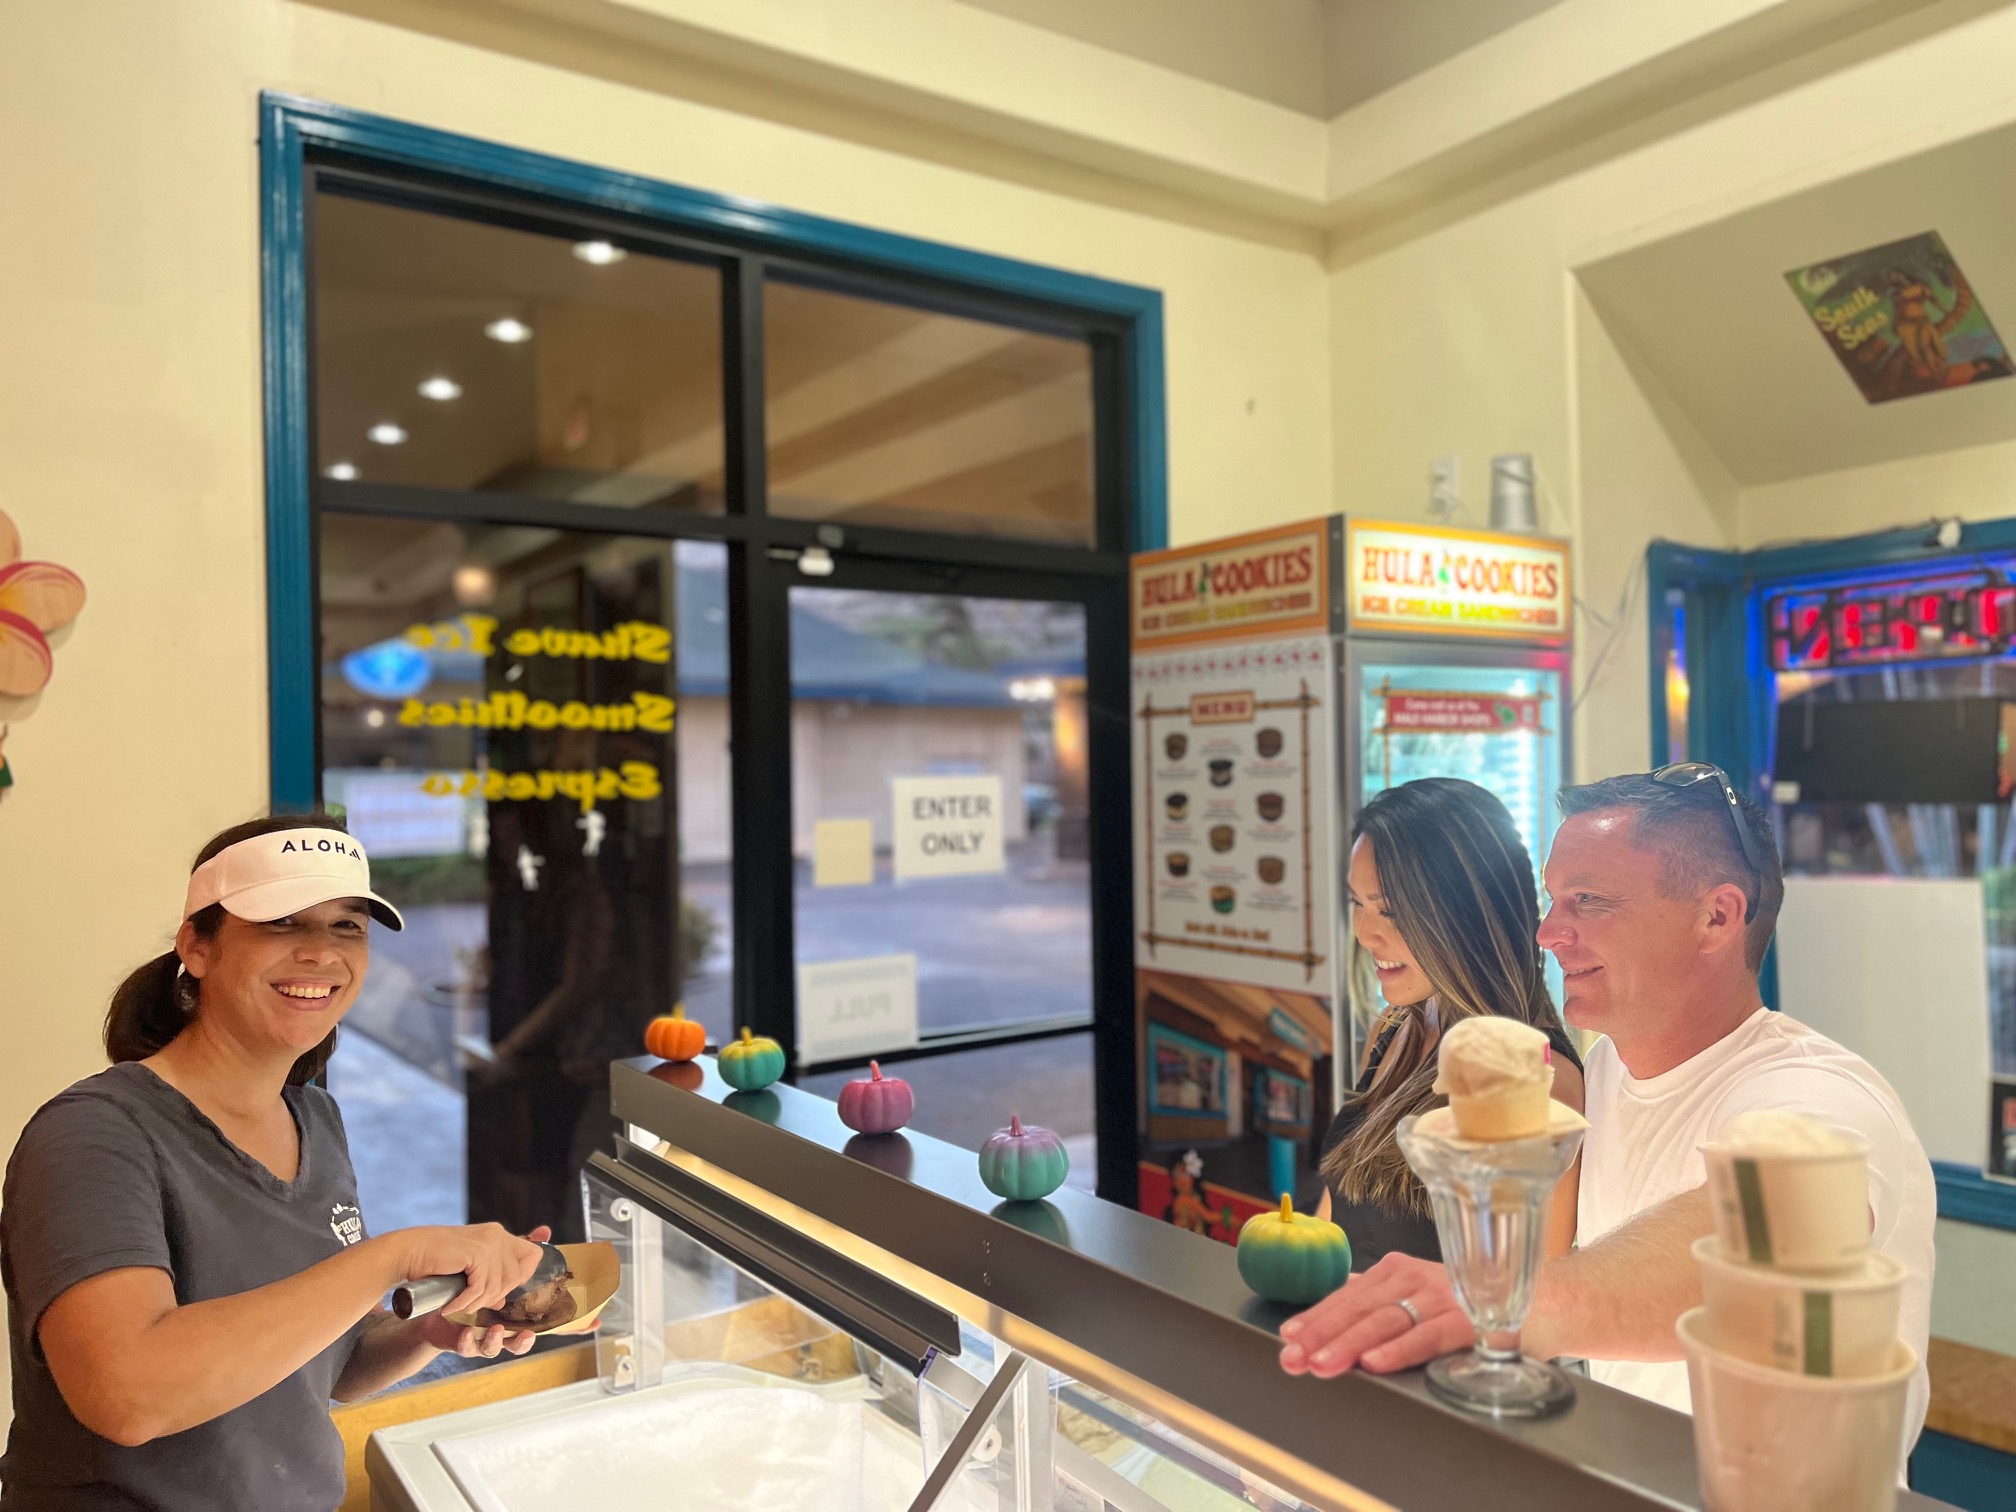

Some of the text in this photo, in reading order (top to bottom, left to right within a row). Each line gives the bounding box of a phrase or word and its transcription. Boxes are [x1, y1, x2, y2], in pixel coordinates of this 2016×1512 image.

[1813, 285, 1878, 332] South
[1837, 310, 1888, 350] Seas
[1141, 546, 1312, 607] HULA COOKIES
[1362, 547, 1558, 600] HULA COOKIES
[1198, 701, 1248, 715] MENU
[912, 795, 992, 820] ENTER
[920, 831, 984, 856] ONLY
